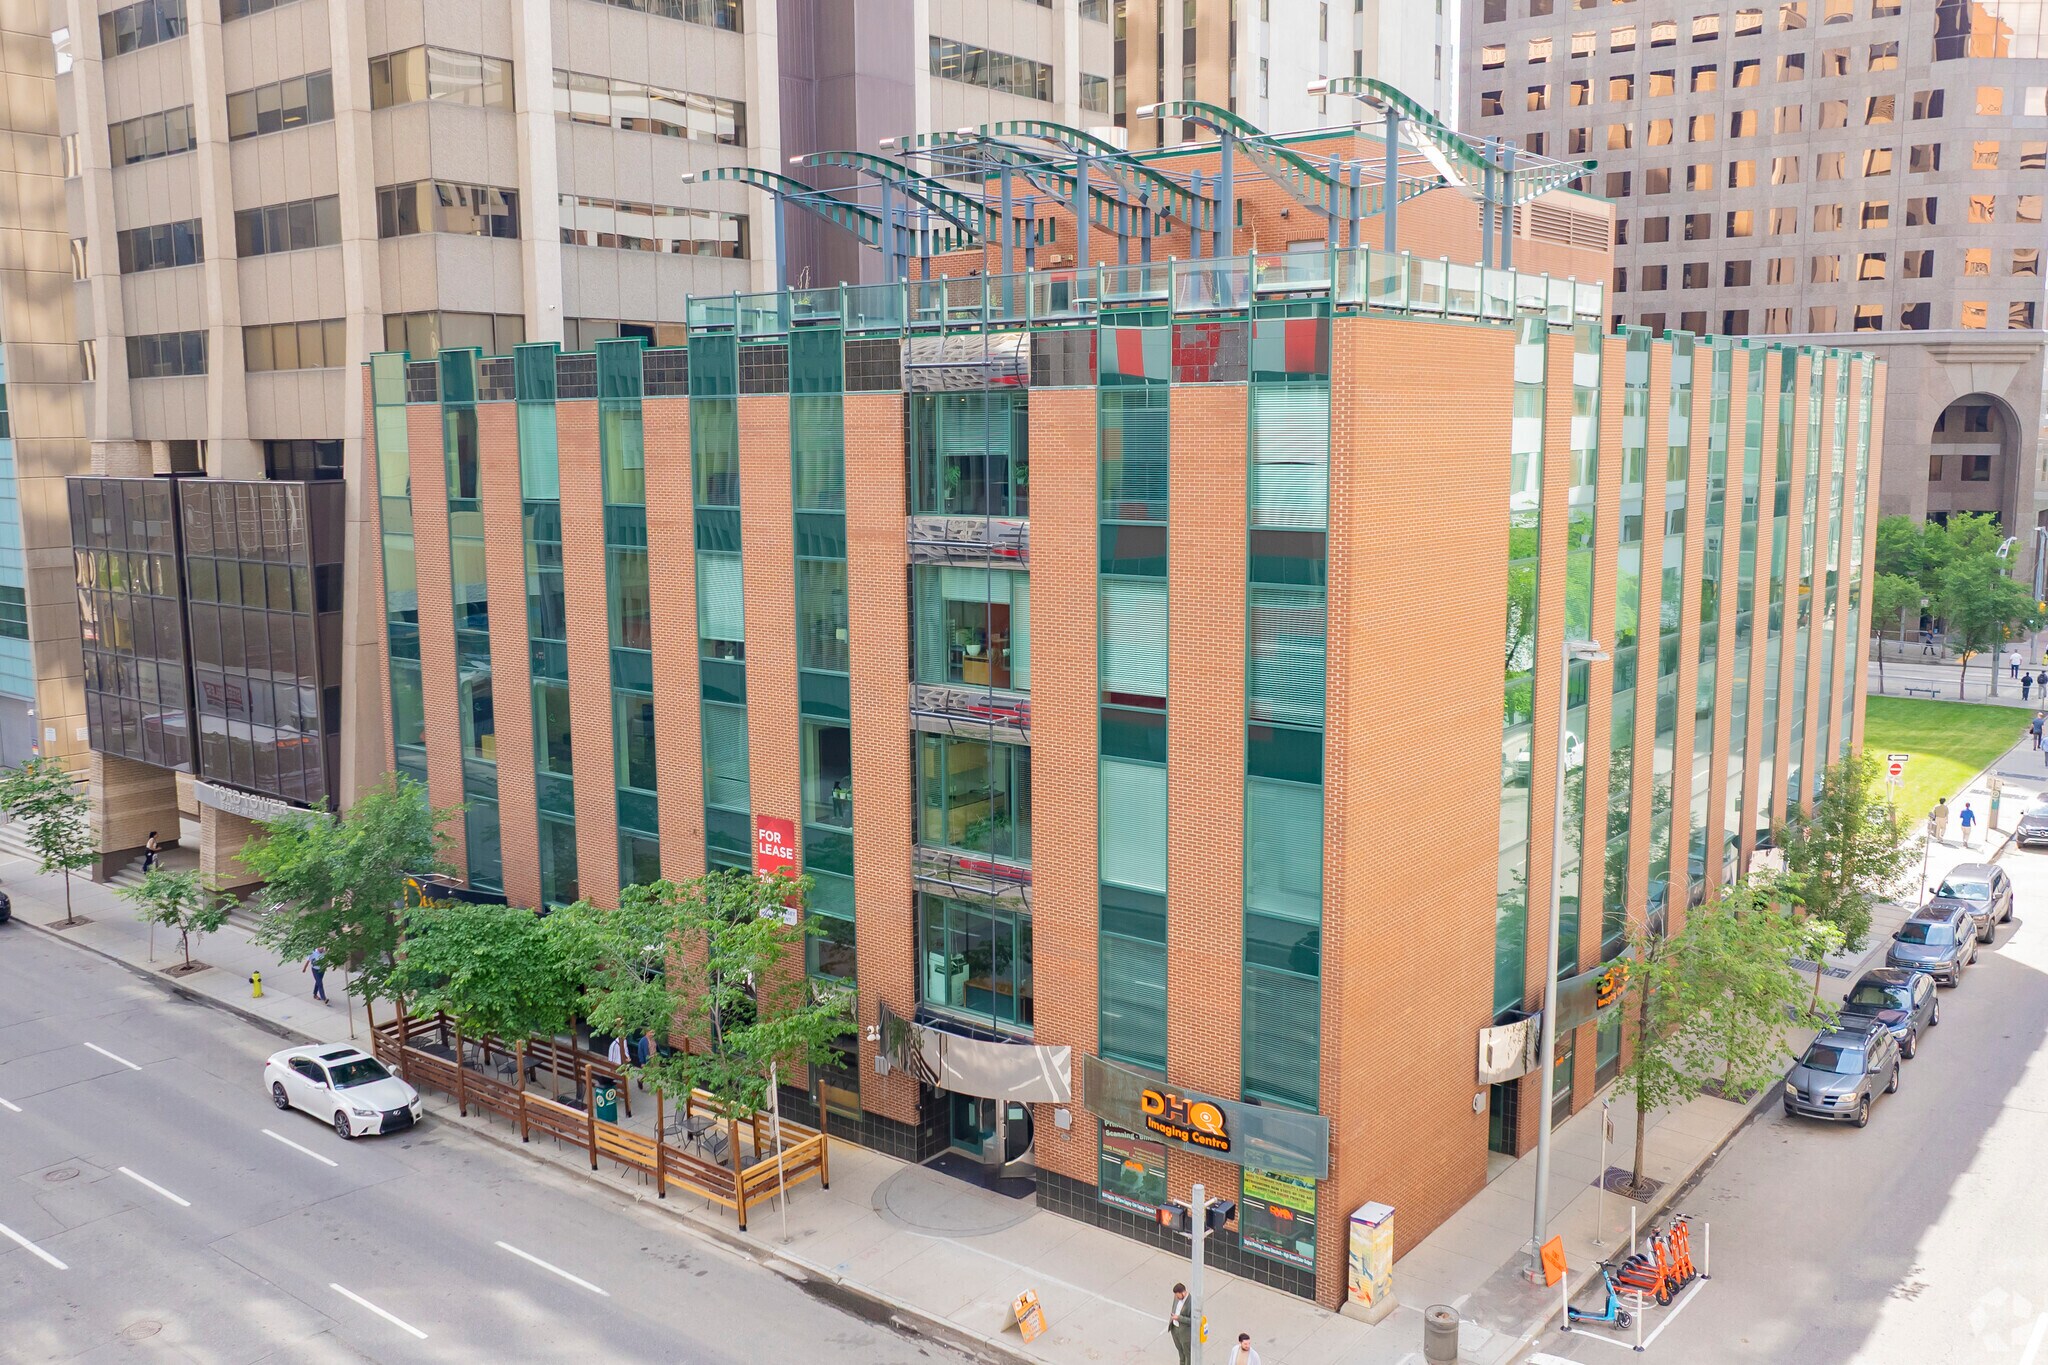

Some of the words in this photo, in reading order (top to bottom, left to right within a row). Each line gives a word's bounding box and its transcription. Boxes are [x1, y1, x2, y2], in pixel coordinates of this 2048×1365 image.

[212, 784, 241, 804] FORD
[241, 791, 288, 815] TOWER
[758, 829, 781, 844] FOR
[759, 842, 794, 860] LEASE
[1141, 1088, 1228, 1138] DHQ
[1105, 1129, 1135, 1140] Scanning
[1147, 1116, 1189, 1142] Imaging
[1191, 1131, 1229, 1150] Centre
